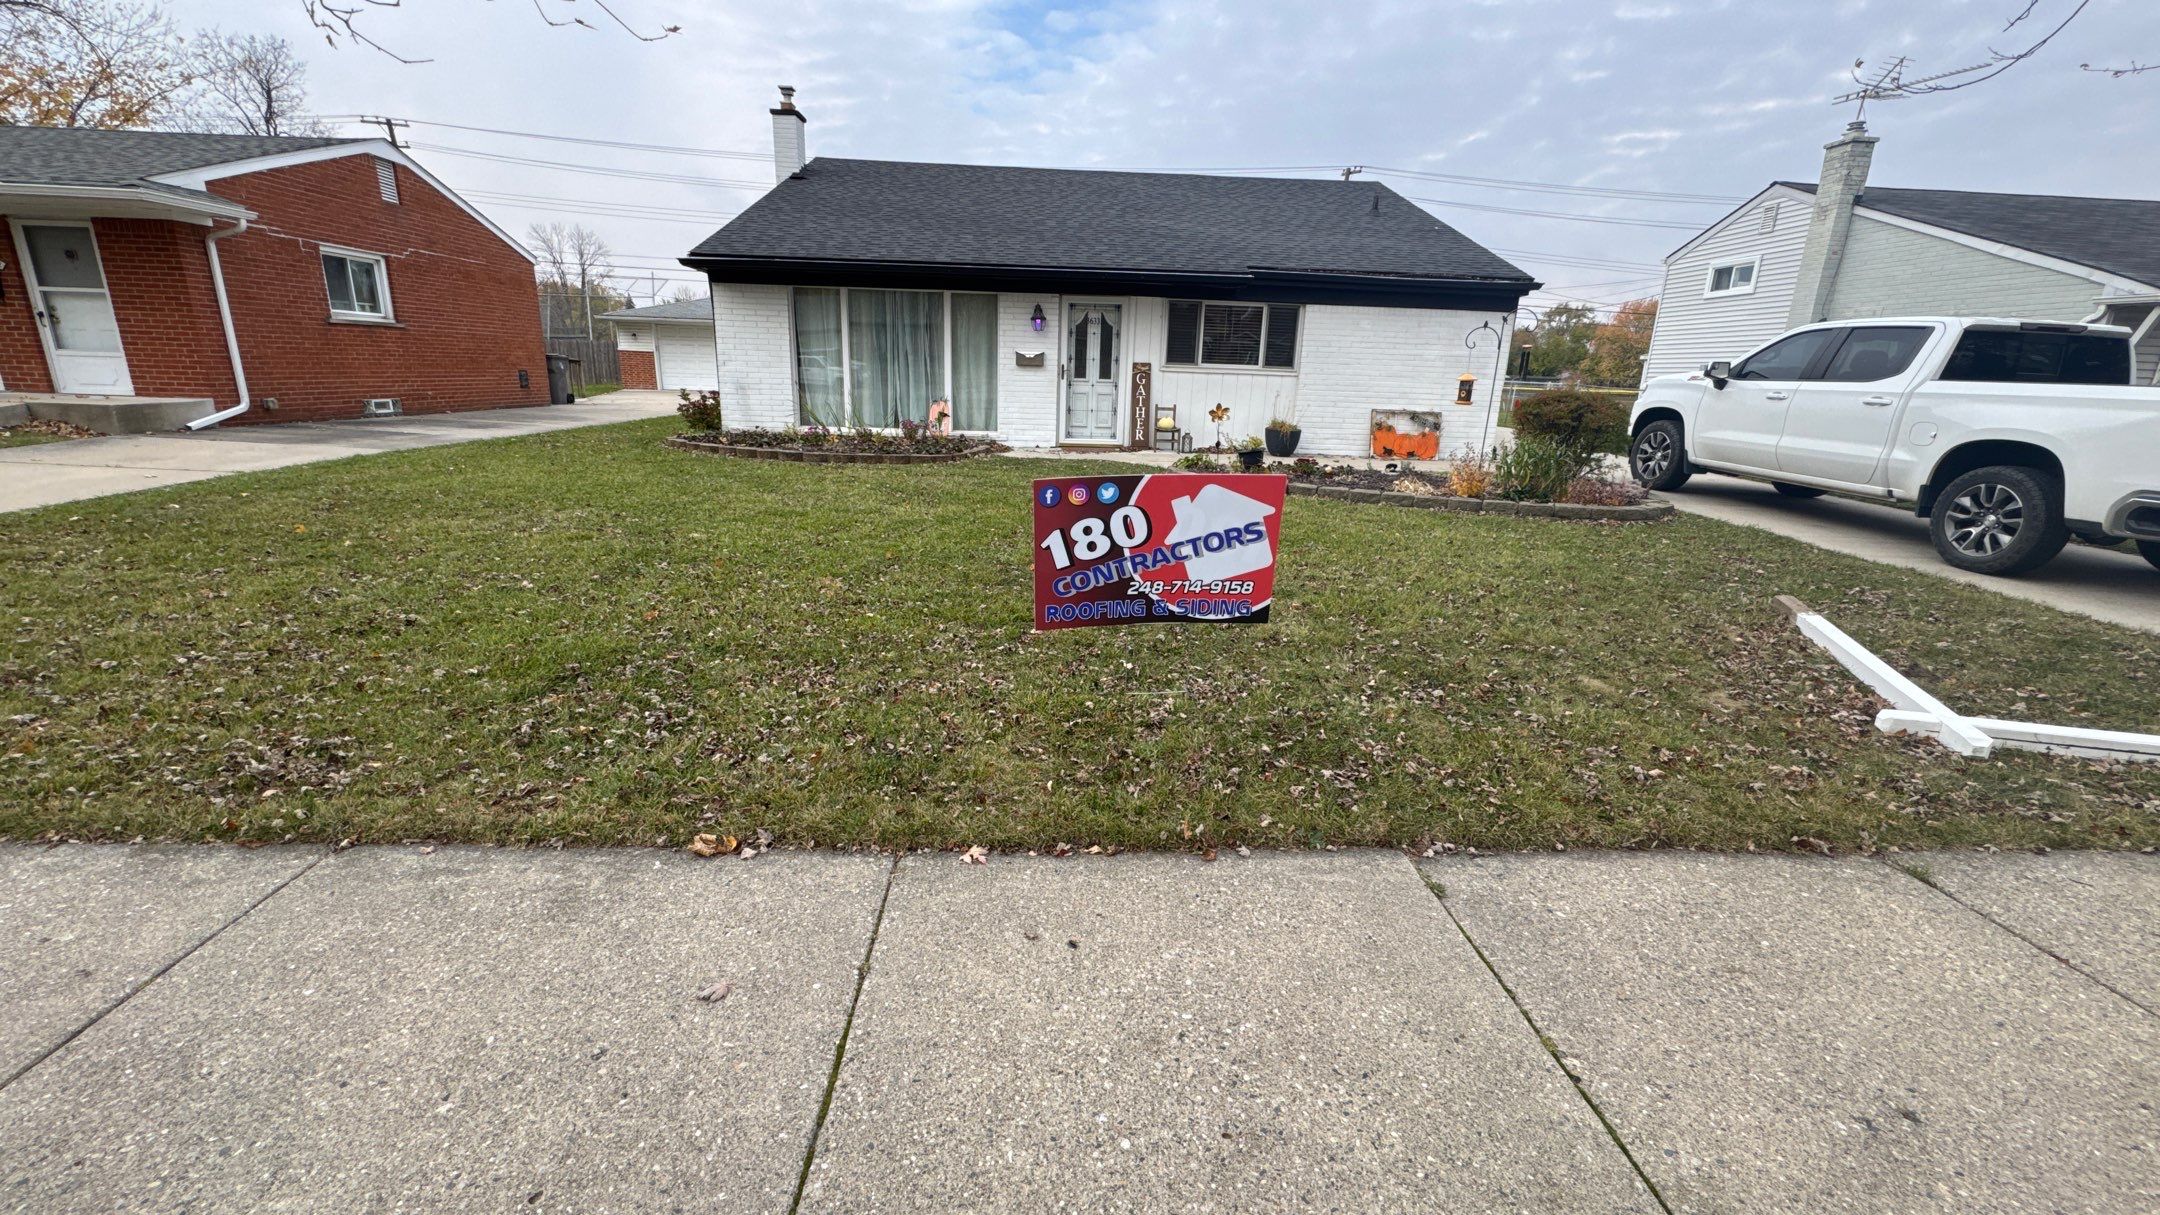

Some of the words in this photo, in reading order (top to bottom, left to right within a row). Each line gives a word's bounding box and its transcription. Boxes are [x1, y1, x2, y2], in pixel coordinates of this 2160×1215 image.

[1135, 373, 1146, 441] GATHER
[1040, 505, 1151, 570] 180
[1052, 521, 1267, 598] CONTRACTORS
[1045, 599, 1146, 623] ROOFING
[1153, 599, 1169, 616] &
[1175, 599, 1253, 618] SIDING
[1126, 580, 1255, 596] 248-714-9158
